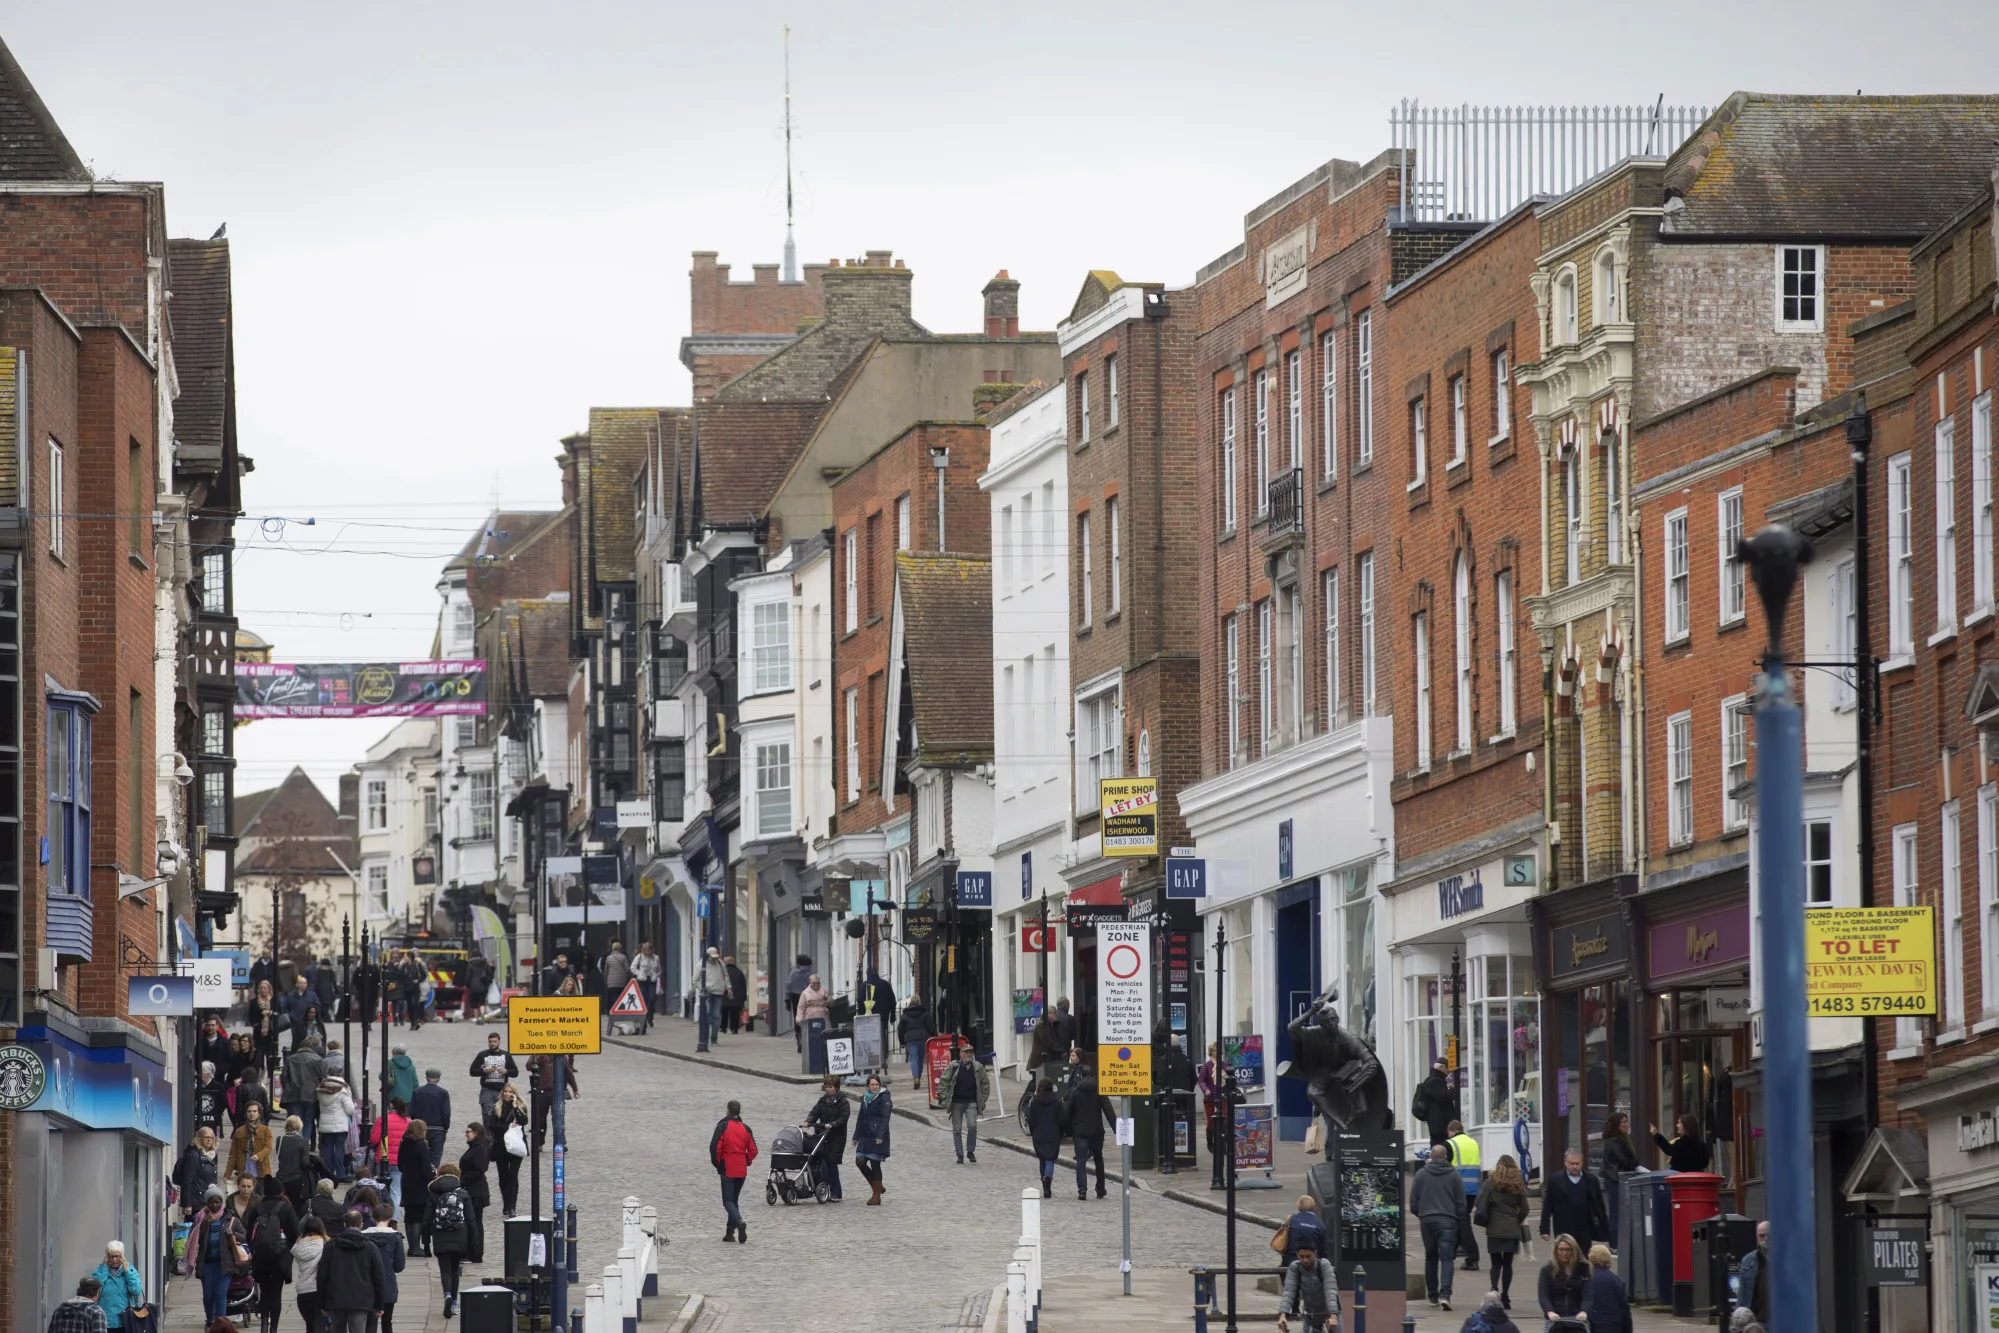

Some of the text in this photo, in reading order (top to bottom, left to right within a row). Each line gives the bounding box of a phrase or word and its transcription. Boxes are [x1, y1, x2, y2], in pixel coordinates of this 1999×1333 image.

[1103, 785, 1154, 795] PRIME SHOP
[1110, 793, 1151, 816] LET BY
[1107, 827, 1148, 835] ISHERWOOD
[1105, 836, 1155, 846] 01483 300176
[1174, 868, 1199, 888] GAP
[964, 878, 984, 893] GAP
[1438, 867, 1484, 920] WHSmith
[1834, 911, 1865, 919] FLOOR
[1876, 909, 1926, 917] BASEMENT
[1107, 932, 1140, 942] ZONE
[1820, 939, 1901, 955] TO LET
[1881, 963, 1923, 976] DAVIS
[193, 974, 222, 986] M&S
[1821, 980, 1863, 990] Company
[1860, 995, 1926, 1011] 579440
[518, 1016, 556, 1024] Farmer's
[559, 1043, 588, 1051] 5.00pm
[0, 1049, 42, 1075] RBUCKS
[0, 1090, 35, 1106] OFFEE
[1873, 1241, 1919, 1268] PILATES
